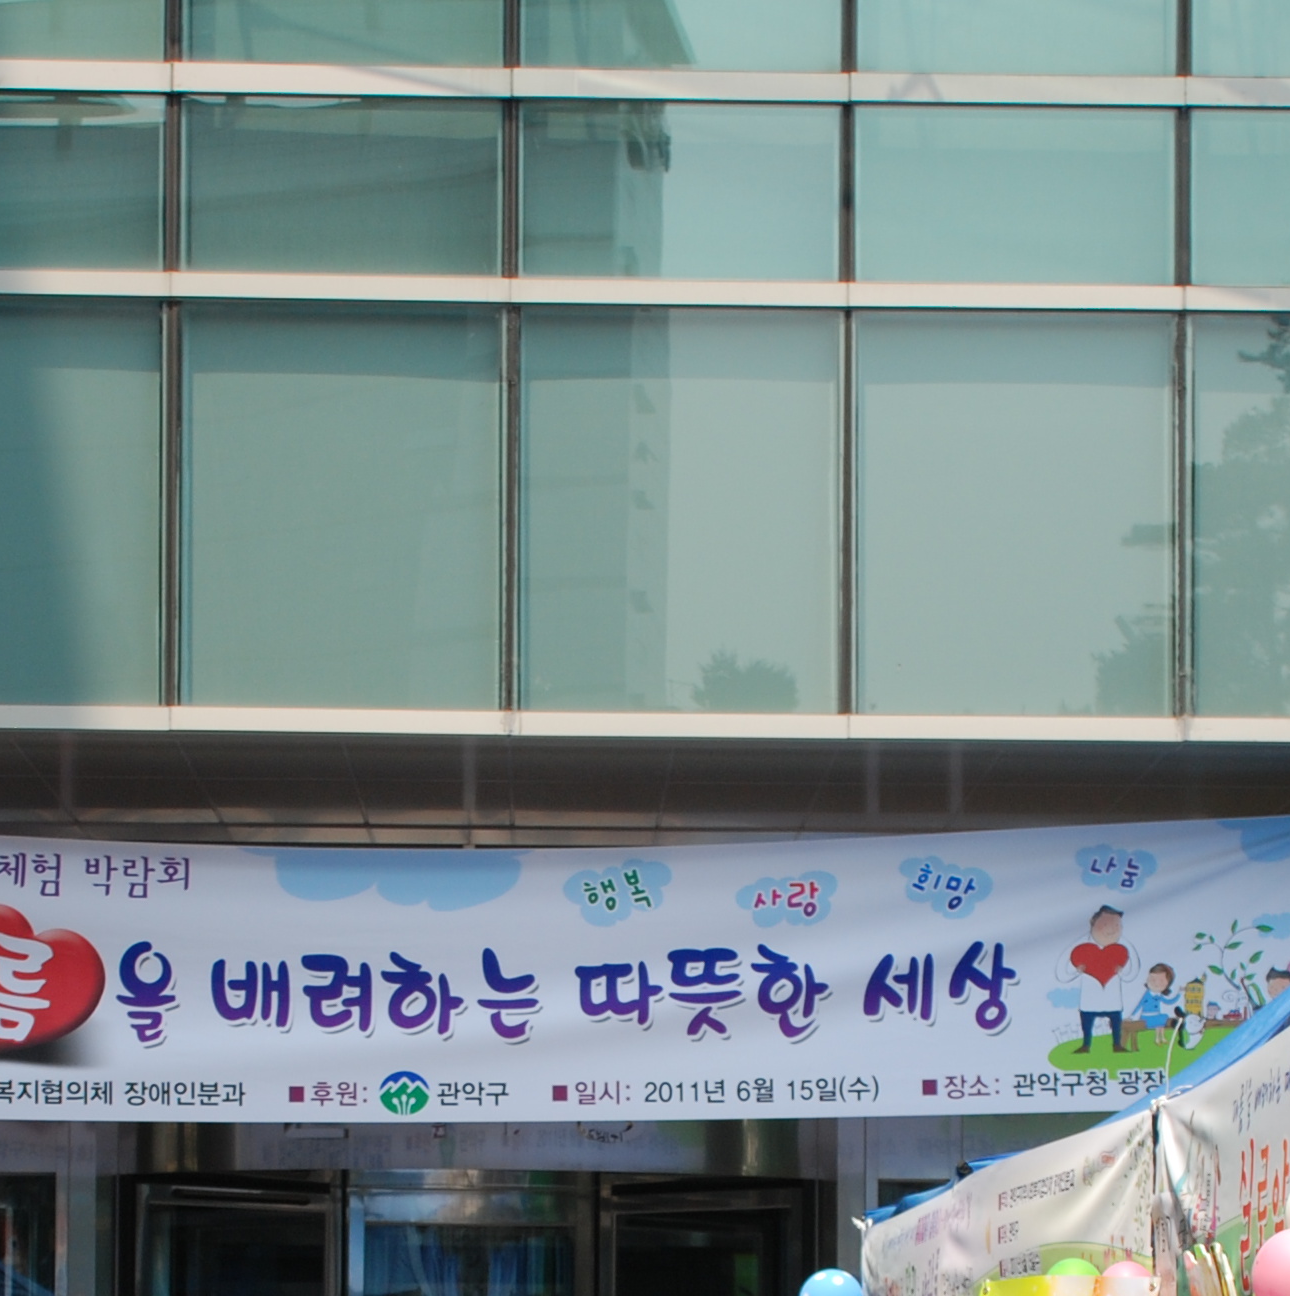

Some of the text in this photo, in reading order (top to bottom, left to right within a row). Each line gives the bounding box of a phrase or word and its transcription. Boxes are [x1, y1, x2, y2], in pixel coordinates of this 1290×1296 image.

[84, 854, 192, 898] 박람회
[582, 869, 652, 912] 행복
[912, 864, 977, 910] 희망
[1090, 855, 1141, 891] 나눔
[753, 881, 820, 918] 사랑
[210, 946, 541, 1040] 배려하는
[577, 940, 834, 1043] 따뜻한
[861, 939, 1019, 1032] 세상
[124, 1079, 246, 1109] 장애인분과
[310, 1076, 509, 1108] 후원: 관악구
[574, 1071, 881, 1107] 일시: 2011년 6월 15일(수)
[944, 1069, 1166, 1099] 장소: 관악구청 광장
